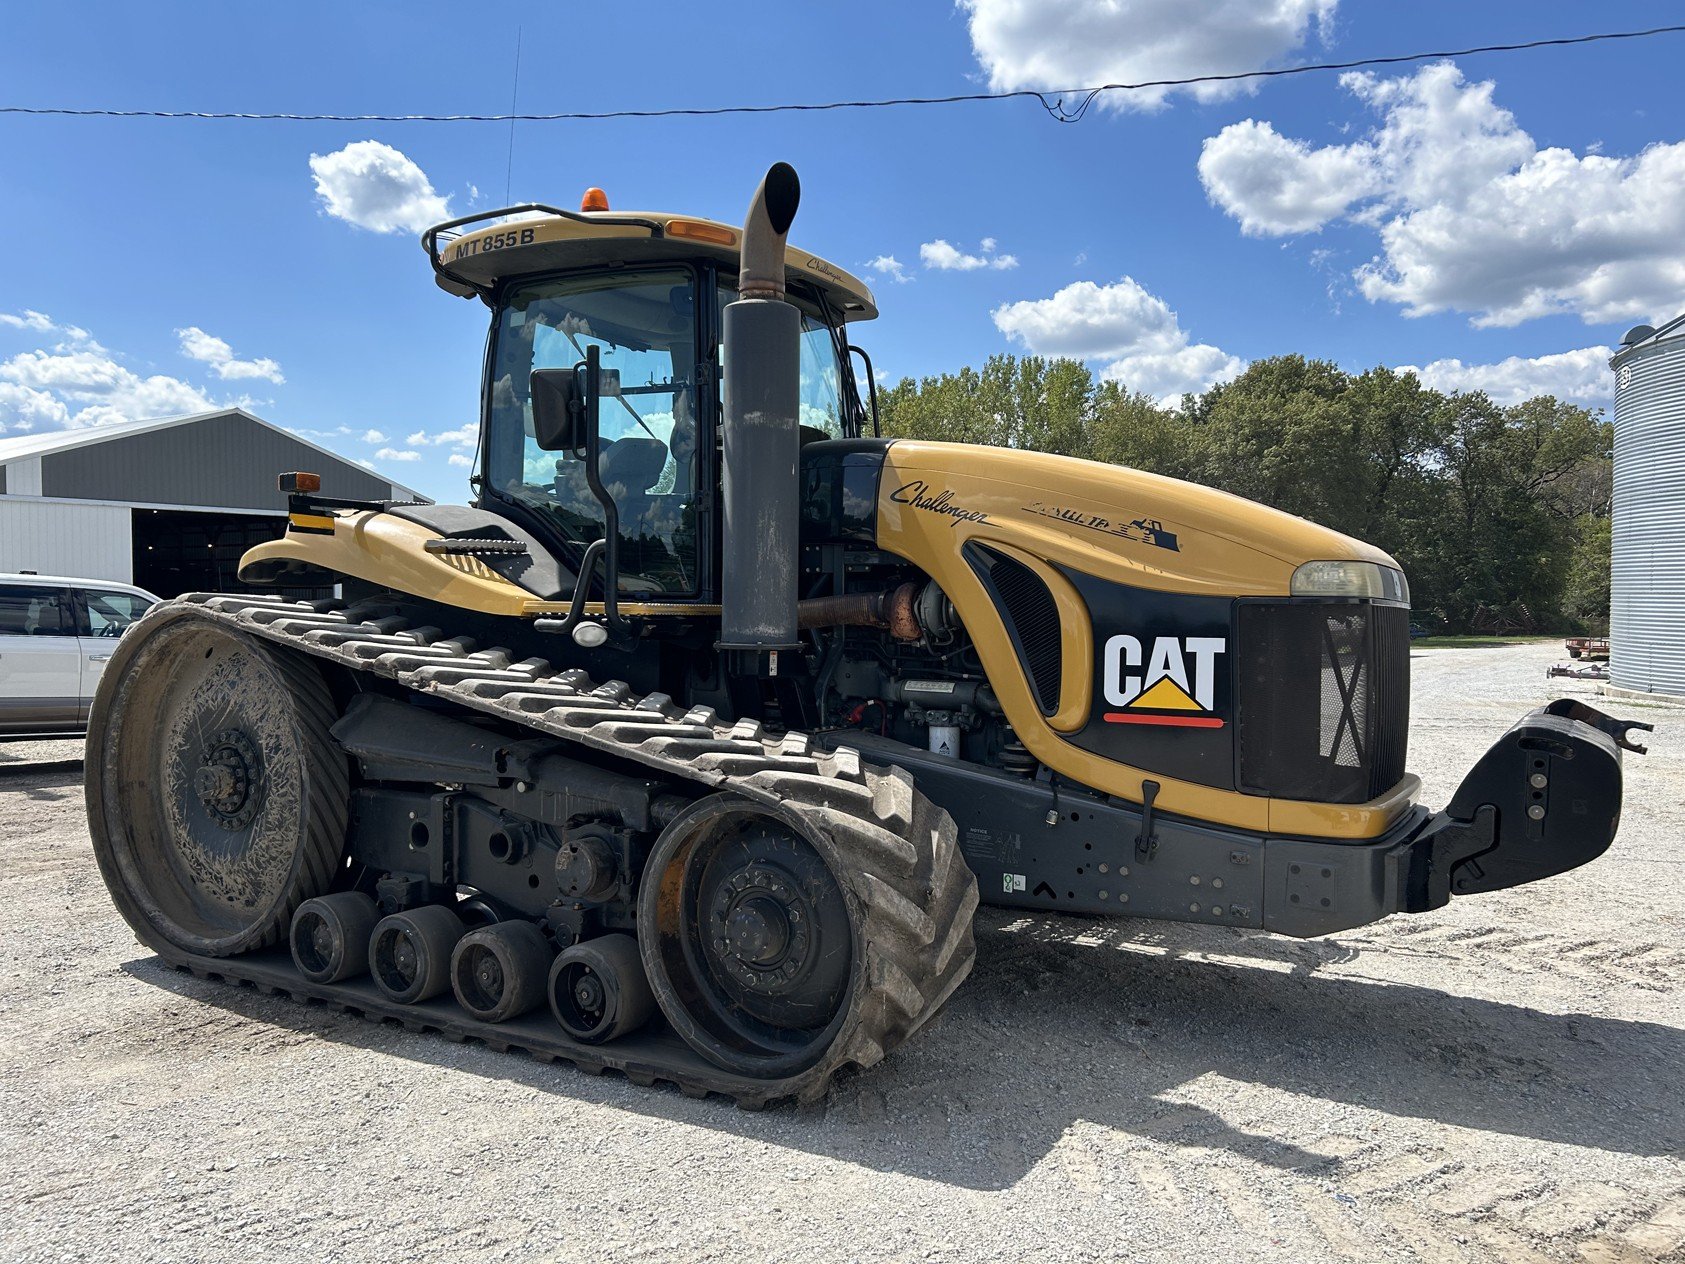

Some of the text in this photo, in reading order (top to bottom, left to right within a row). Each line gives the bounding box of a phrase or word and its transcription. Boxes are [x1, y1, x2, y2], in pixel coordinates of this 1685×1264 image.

[807, 257, 846, 282] Challenger
[890, 480, 1003, 527] Challenger
[1103, 634, 1226, 711] CAT
[969, 827, 988, 835] NOTICE
